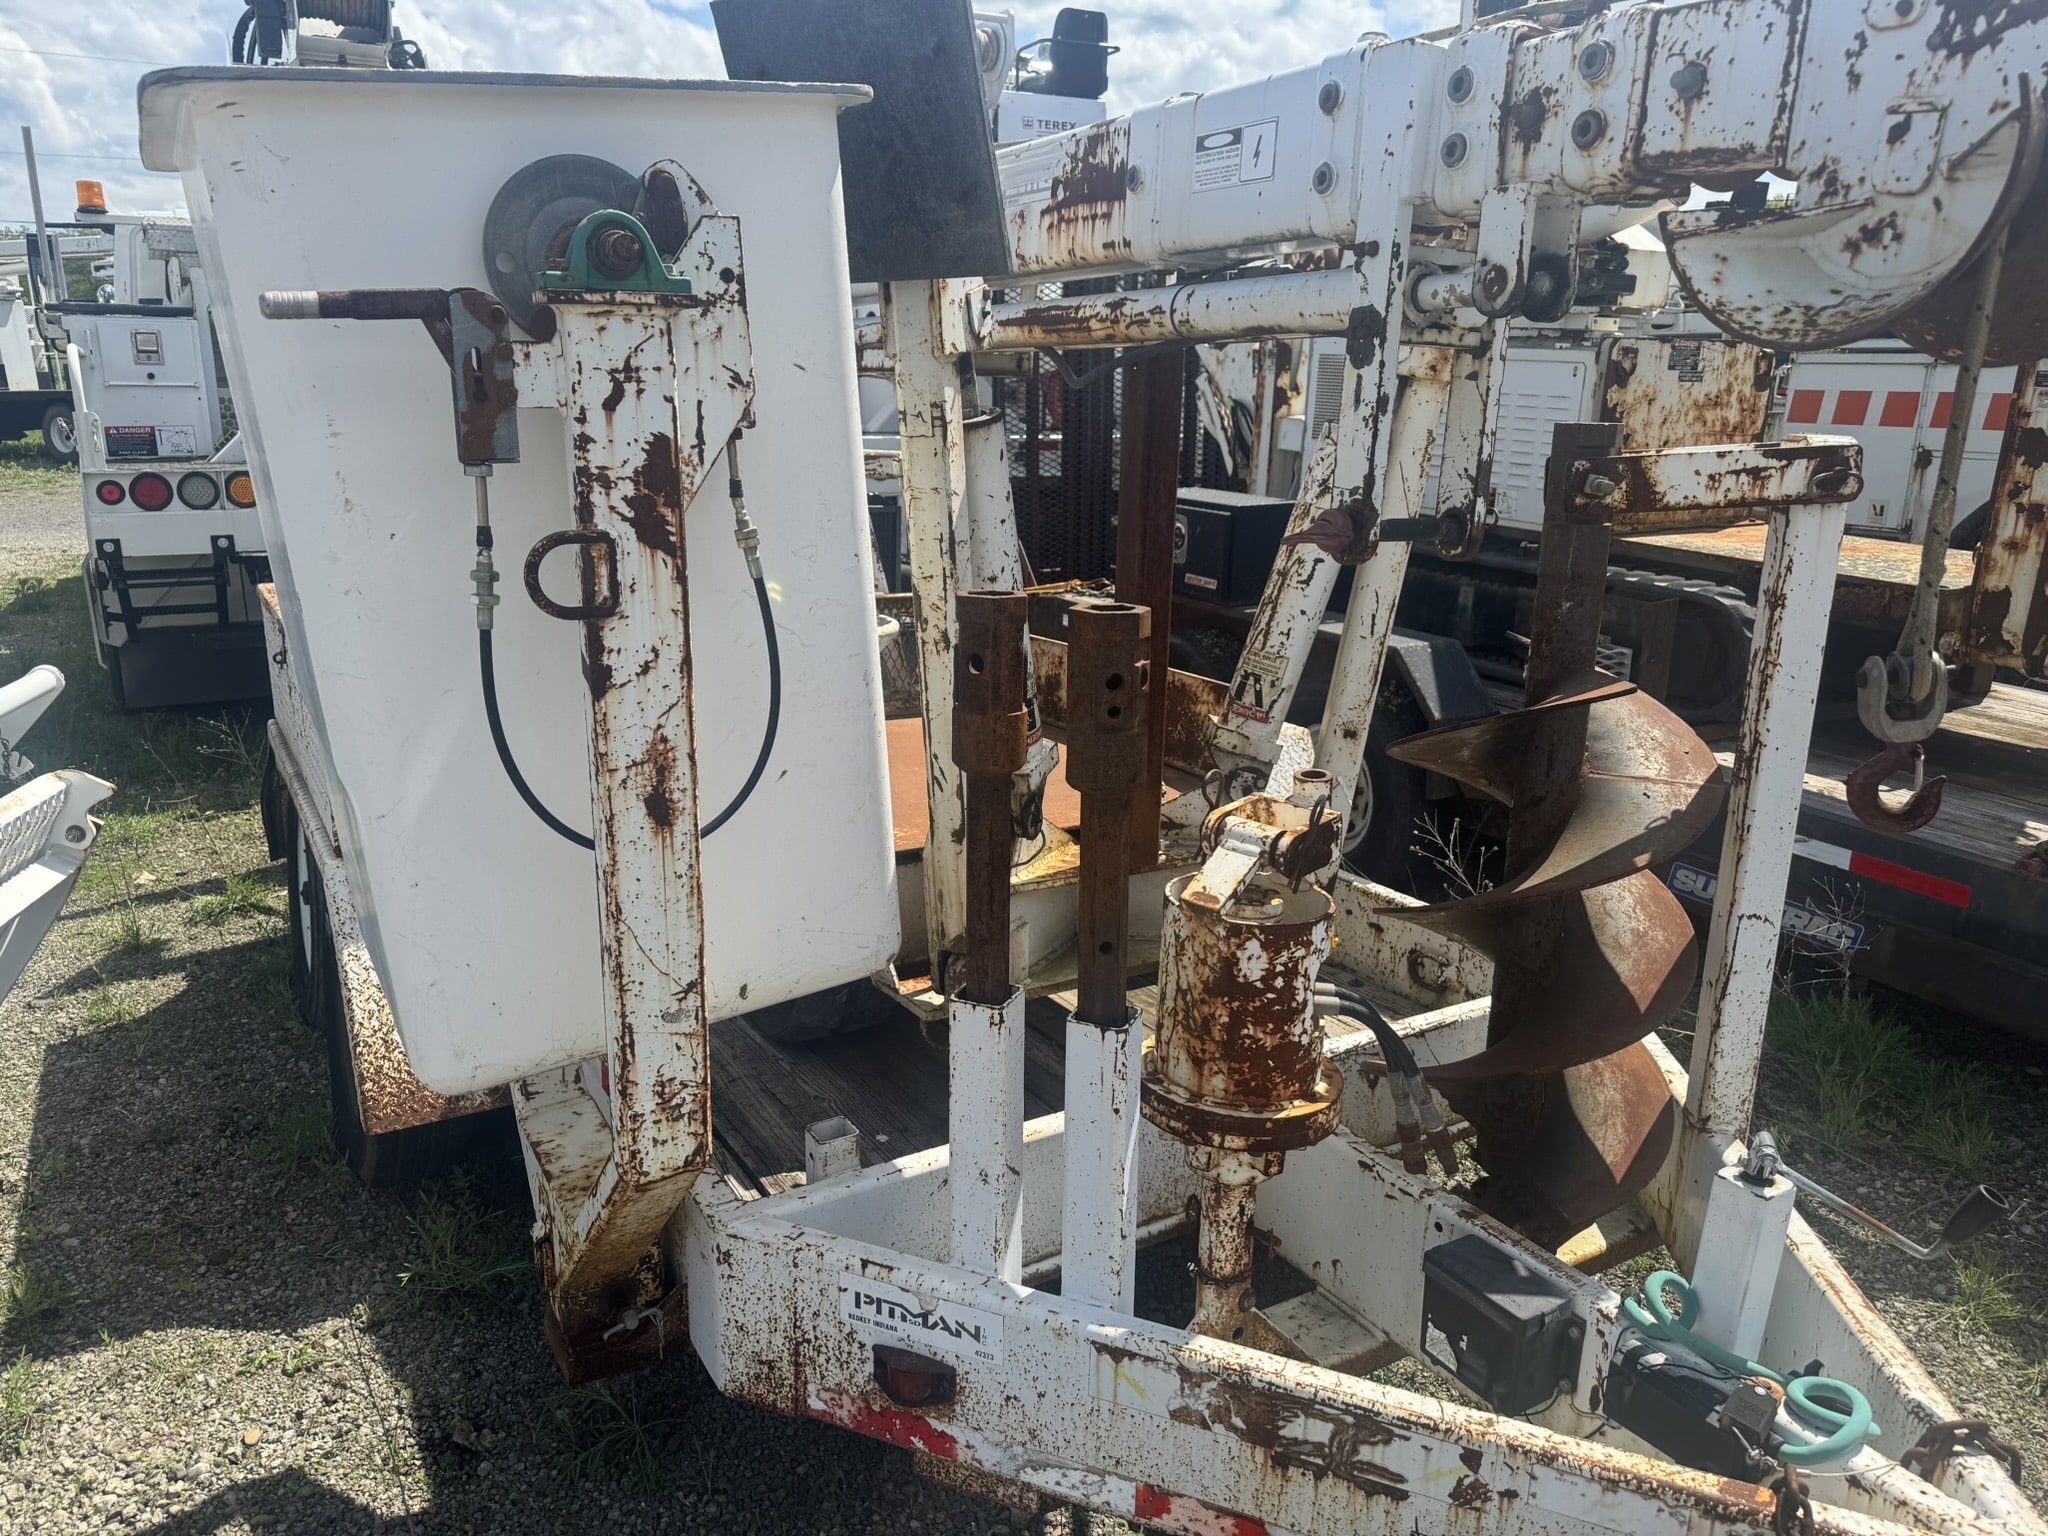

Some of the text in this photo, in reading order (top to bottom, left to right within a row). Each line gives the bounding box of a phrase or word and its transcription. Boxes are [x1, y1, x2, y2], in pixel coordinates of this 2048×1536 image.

[1036, 119, 1077, 131] TEREX
[855, 1291, 981, 1345] PITMAN
[872, 1320, 899, 1333] INDIANA
[974, 1349, 994, 1361] 47373
